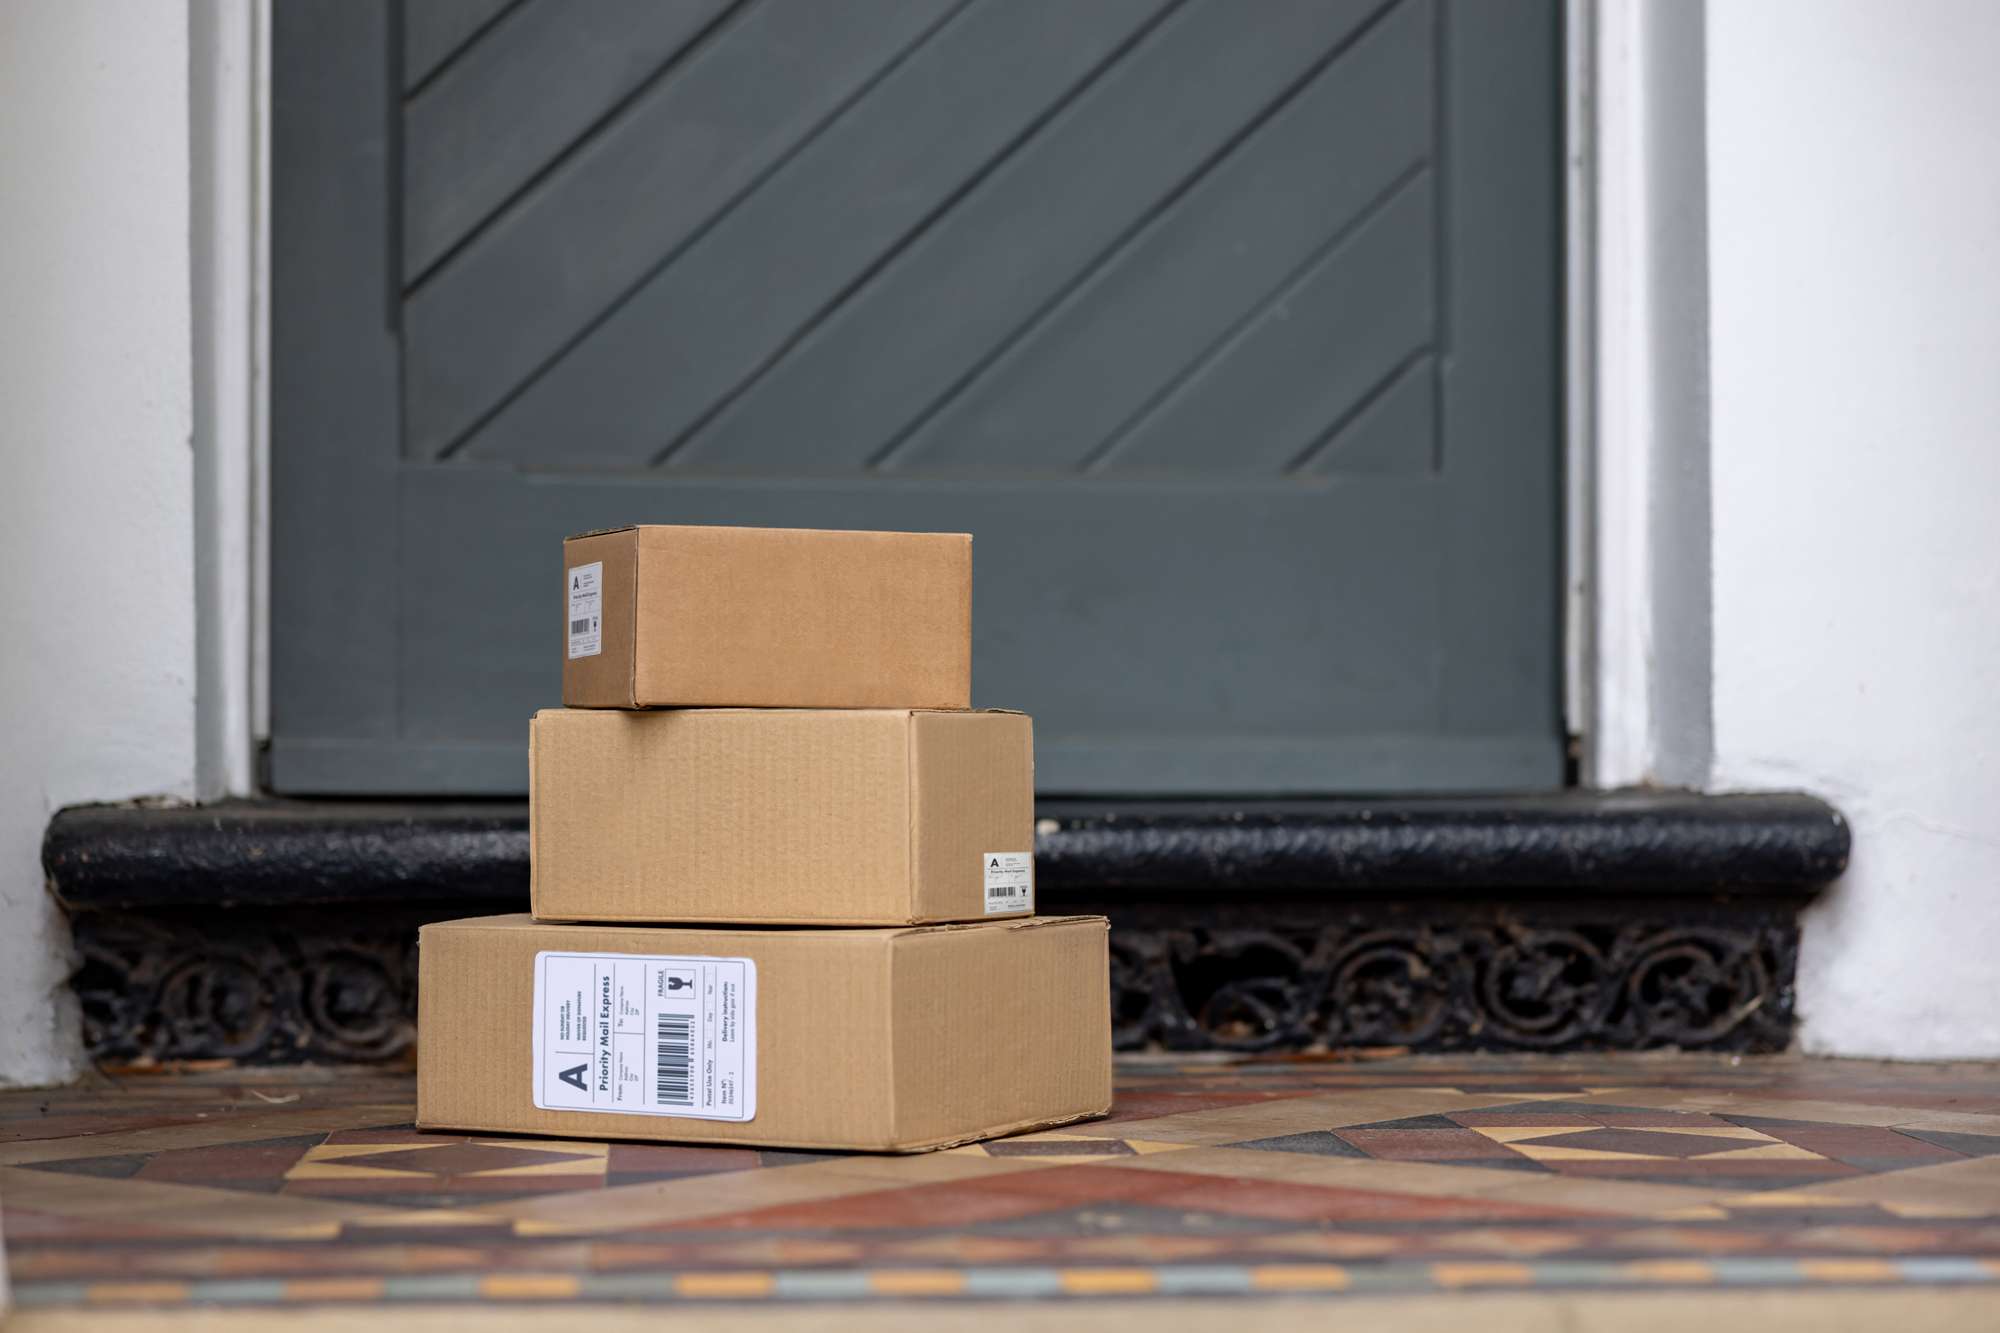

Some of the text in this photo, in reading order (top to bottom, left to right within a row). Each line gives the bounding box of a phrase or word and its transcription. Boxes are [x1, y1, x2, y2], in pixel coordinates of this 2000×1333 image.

[573, 576, 580, 591] A
[990, 858, 999, 867] A
[600, 976, 612, 1091] Priority Mail Express
[559, 1064, 588, 1091] A
